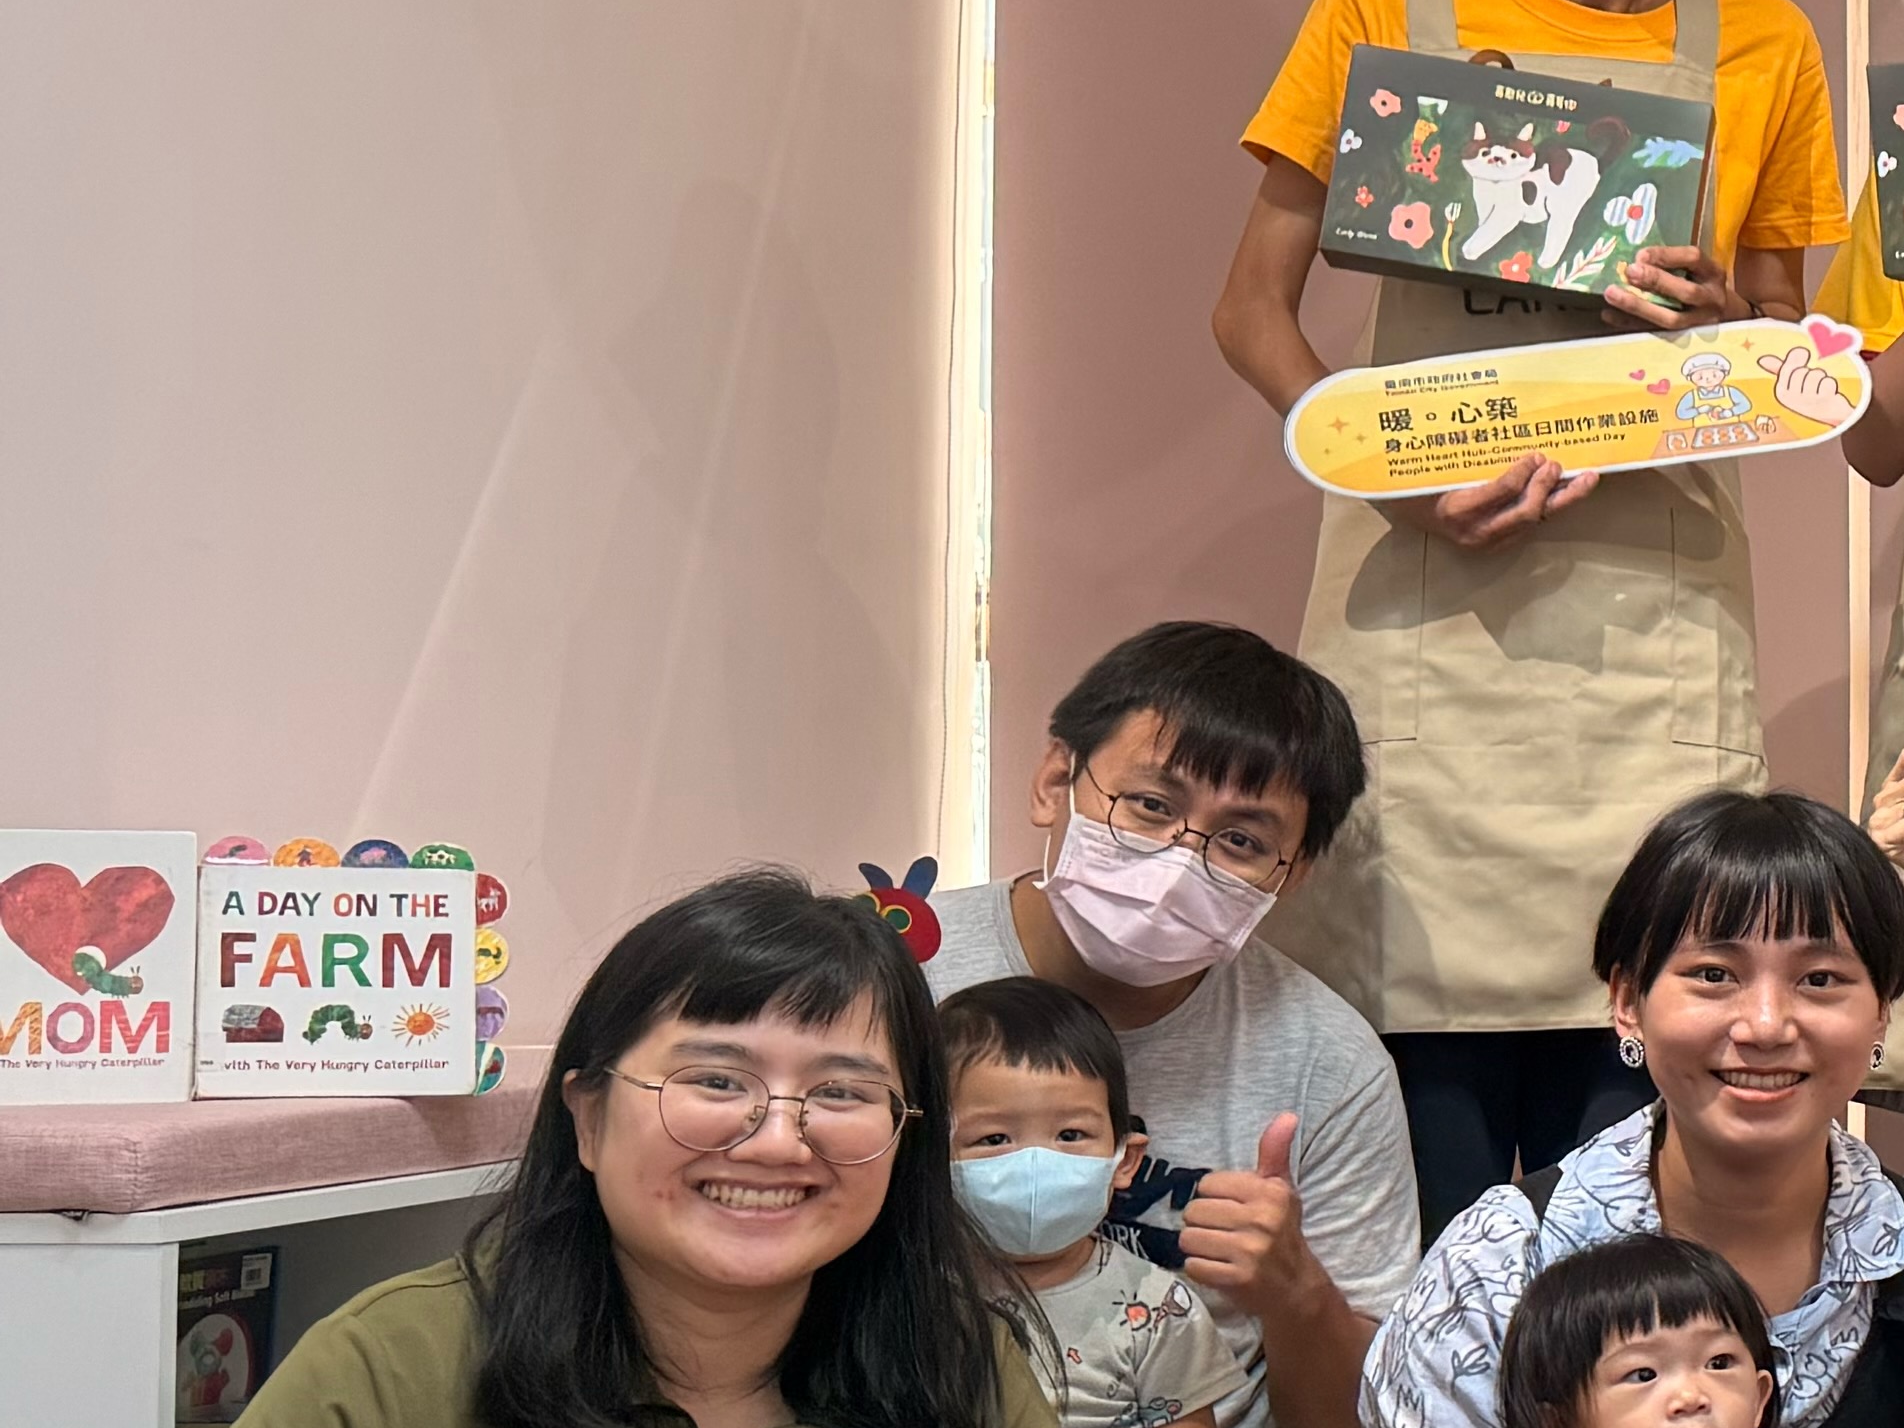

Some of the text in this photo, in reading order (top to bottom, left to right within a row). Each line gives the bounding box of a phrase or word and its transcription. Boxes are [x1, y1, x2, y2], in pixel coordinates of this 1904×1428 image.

[222, 891, 449, 917] A DAY ON THE
[220, 932, 453, 988] FARM
[256, 1060, 280, 1070] The
[286, 1060, 316, 1072] Very
[321, 1060, 369, 1072] Hungry
[374, 1060, 450, 1072] Caterpillar
